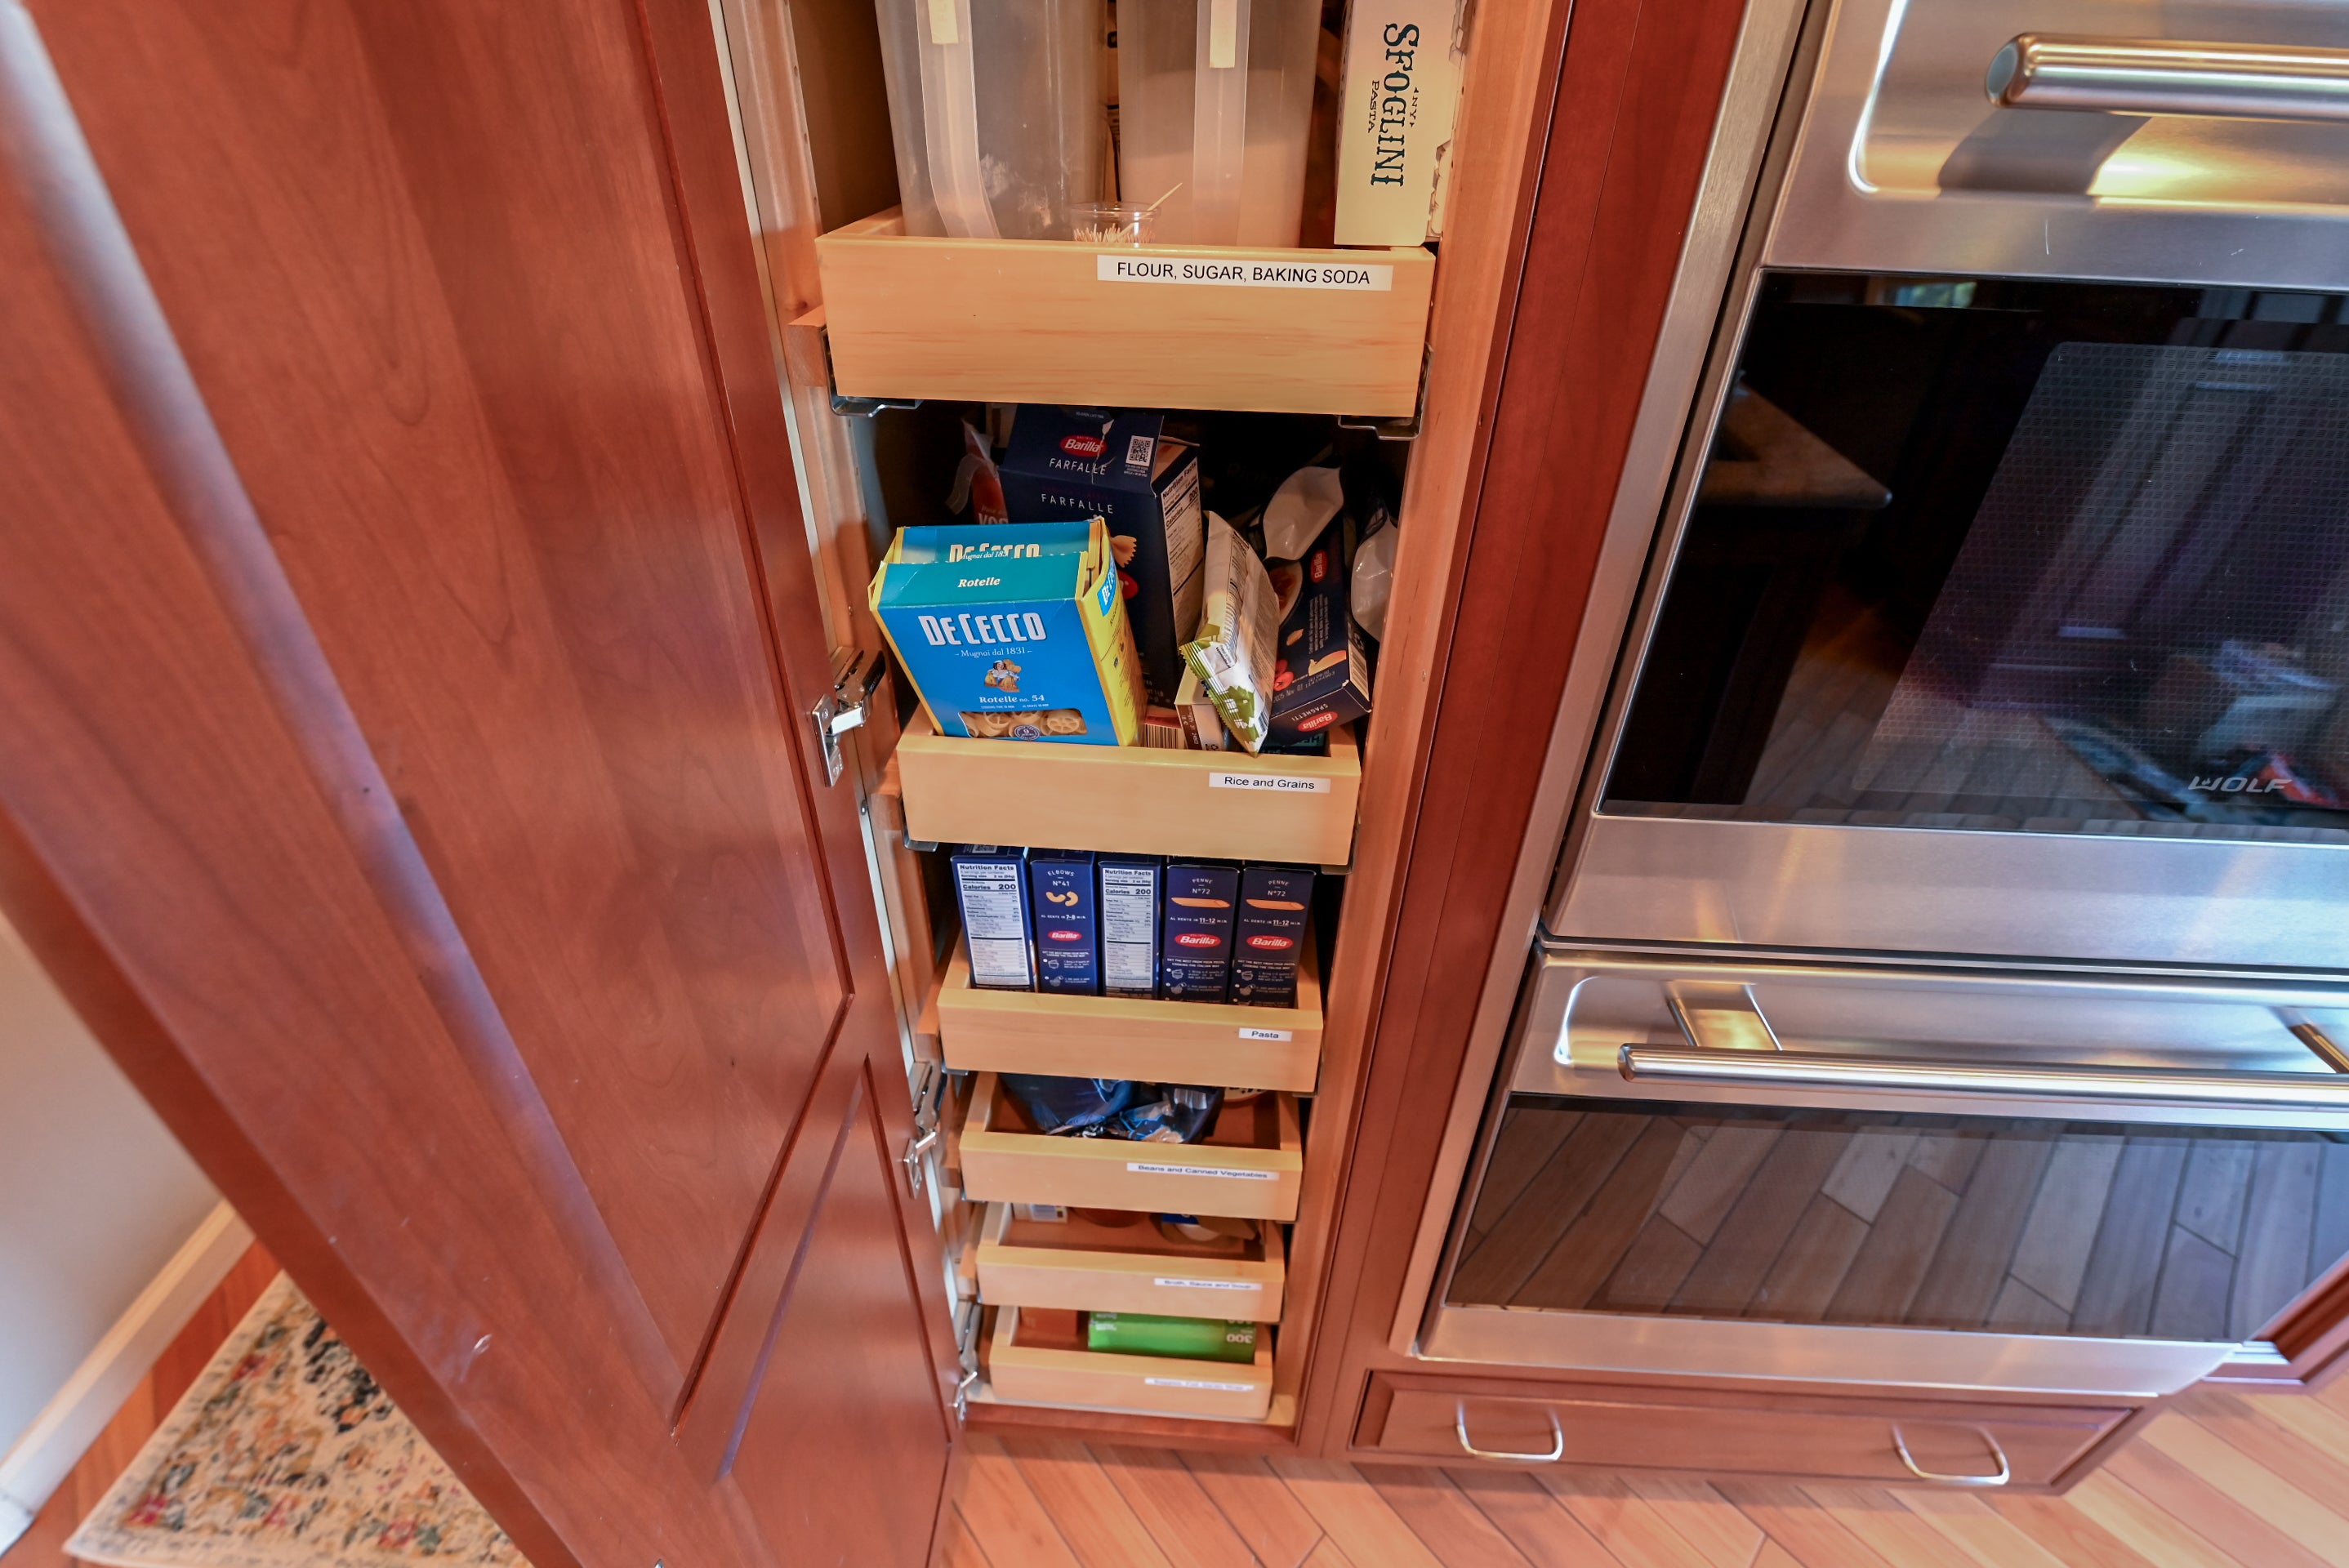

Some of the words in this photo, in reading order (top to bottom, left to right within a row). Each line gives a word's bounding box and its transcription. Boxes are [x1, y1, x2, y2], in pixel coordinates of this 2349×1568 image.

[1367, 80, 1380, 133] PASTA
[1371, 23, 1420, 187] SFOGLINI
[1117, 262, 1177, 280] FLOUR,
[1183, 265, 1246, 282] SUGAR,
[1252, 267, 1317, 283] BAKING
[1322, 270, 1371, 284] SODA
[1064, 439, 1101, 452] Barilla
[1050, 458, 1107, 475] FARFALLE
[1041, 493, 1113, 514] FARFALLE
[957, 577, 1001, 588] Rotelle
[958, 612, 1046, 644] CECCO
[961, 649, 990, 659] Mugnai
[992, 648, 1004, 656] dal
[979, 695, 1018, 703] Rotelle
[1291, 703, 1329, 721] SPAGHETTI
[1302, 713, 1333, 729] Barilla
[1224, 777, 1249, 786] Rice
[1253, 779, 1273, 787] and
[1277, 779, 1315, 789] Grains
[2188, 776, 2293, 793] WOLF
[1180, 936, 1215, 945] Barilla
[1252, 938, 1288, 947] Barilla
[1251, 1031, 1278, 1039] Pasta
[1221, 1170, 1268, 1178] Vegetables
[1227, 1334, 1253, 1343] 300
